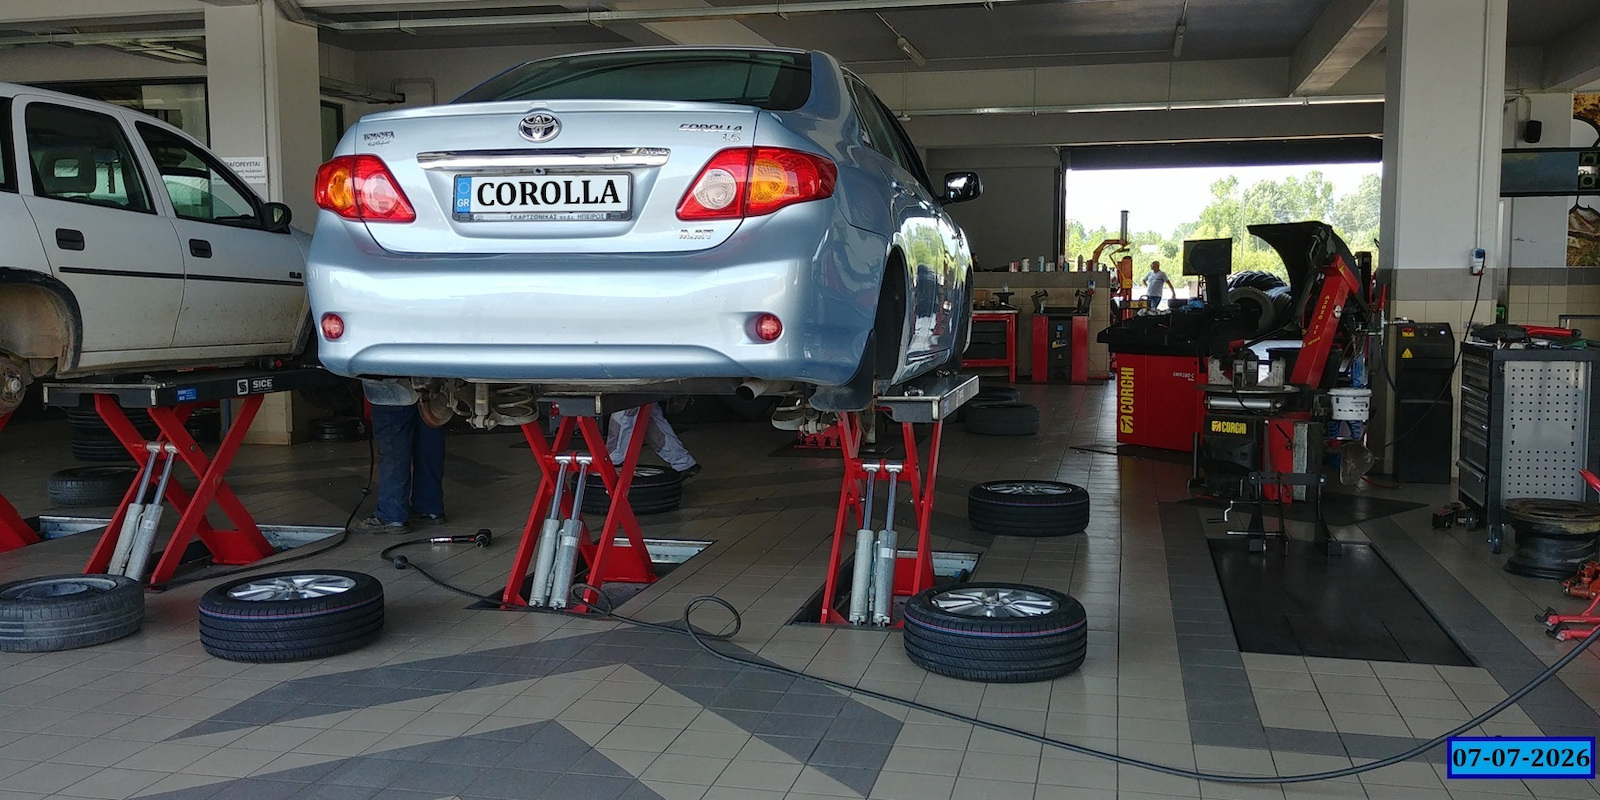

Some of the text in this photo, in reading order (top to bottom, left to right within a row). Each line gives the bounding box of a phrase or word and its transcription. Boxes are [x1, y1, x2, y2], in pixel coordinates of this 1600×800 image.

[678, 123, 742, 132] COROLLA
[457, 180, 621, 207] GR COROLLA
[252, 379, 273, 389] SICE
[1120, 367, 1135, 415] CORGHI
[1221, 421, 1247, 434] CORGHI
